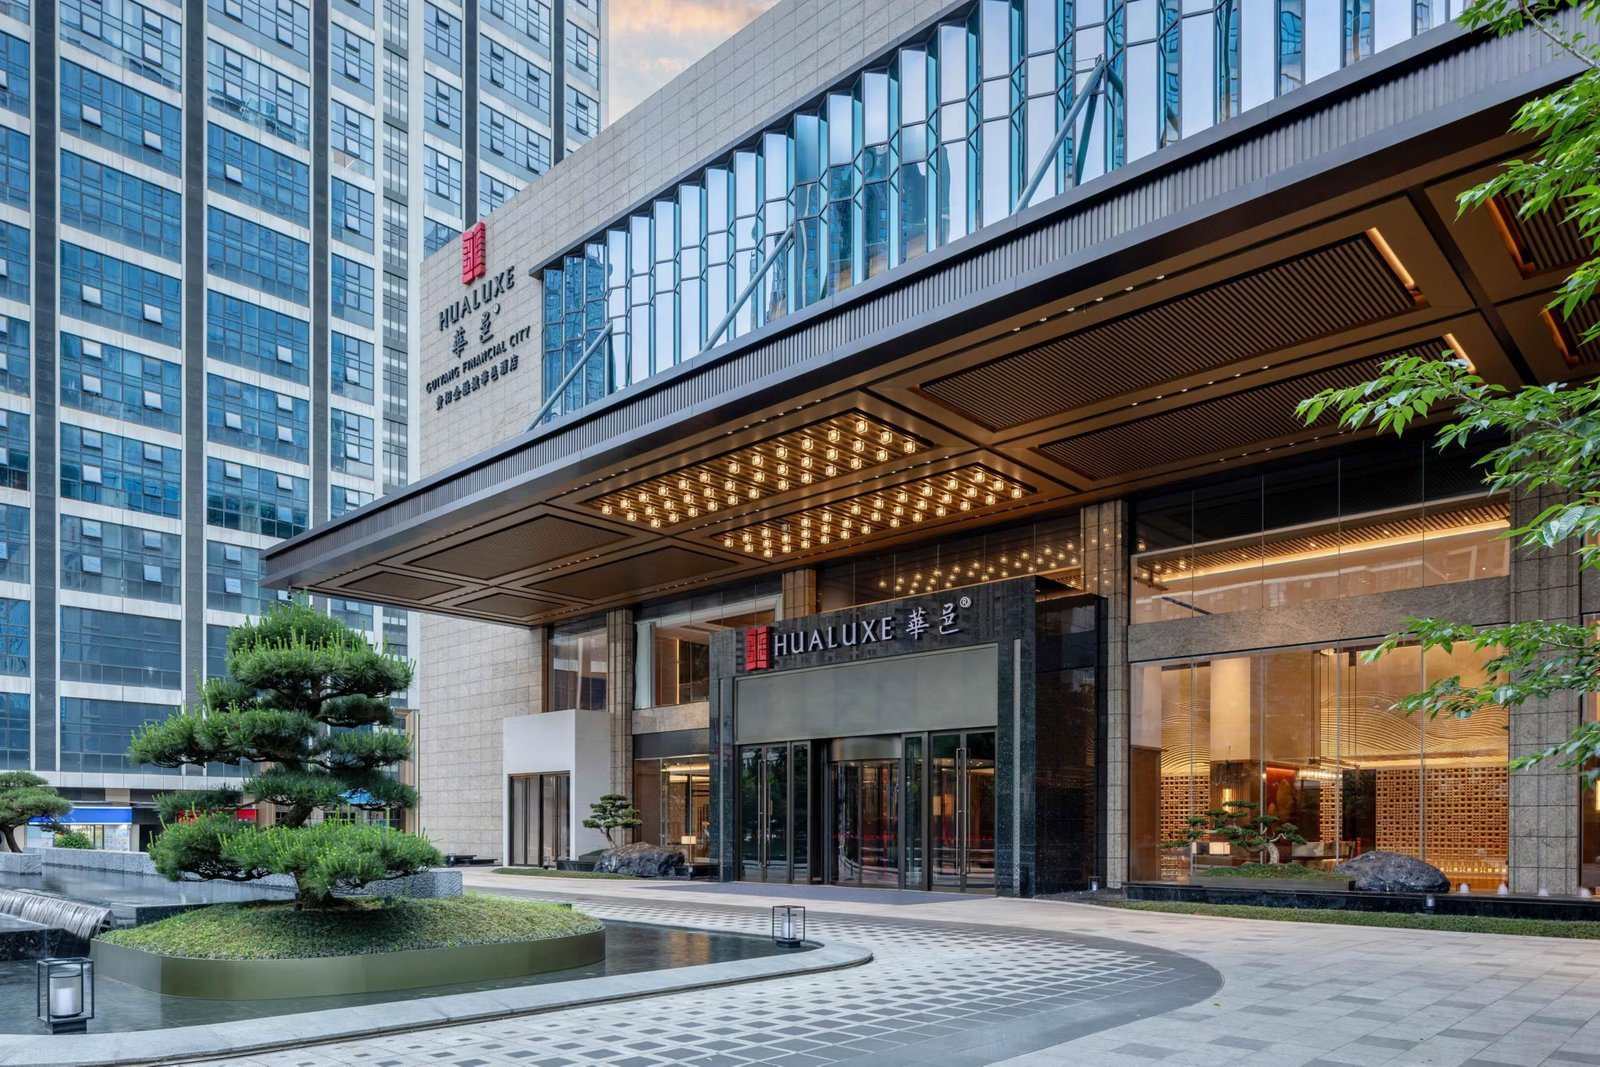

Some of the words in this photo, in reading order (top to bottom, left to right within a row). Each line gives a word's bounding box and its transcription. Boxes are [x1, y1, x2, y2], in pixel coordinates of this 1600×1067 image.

[438, 265, 515, 331] HUALUXE
[426, 366, 460, 393] GUIYANG
[462, 342, 507, 373] FINANCIAL
[509, 326, 531, 347] CITY
[774, 616, 896, 656] HUALUXE
[905, 602, 960, 640] 華邑
